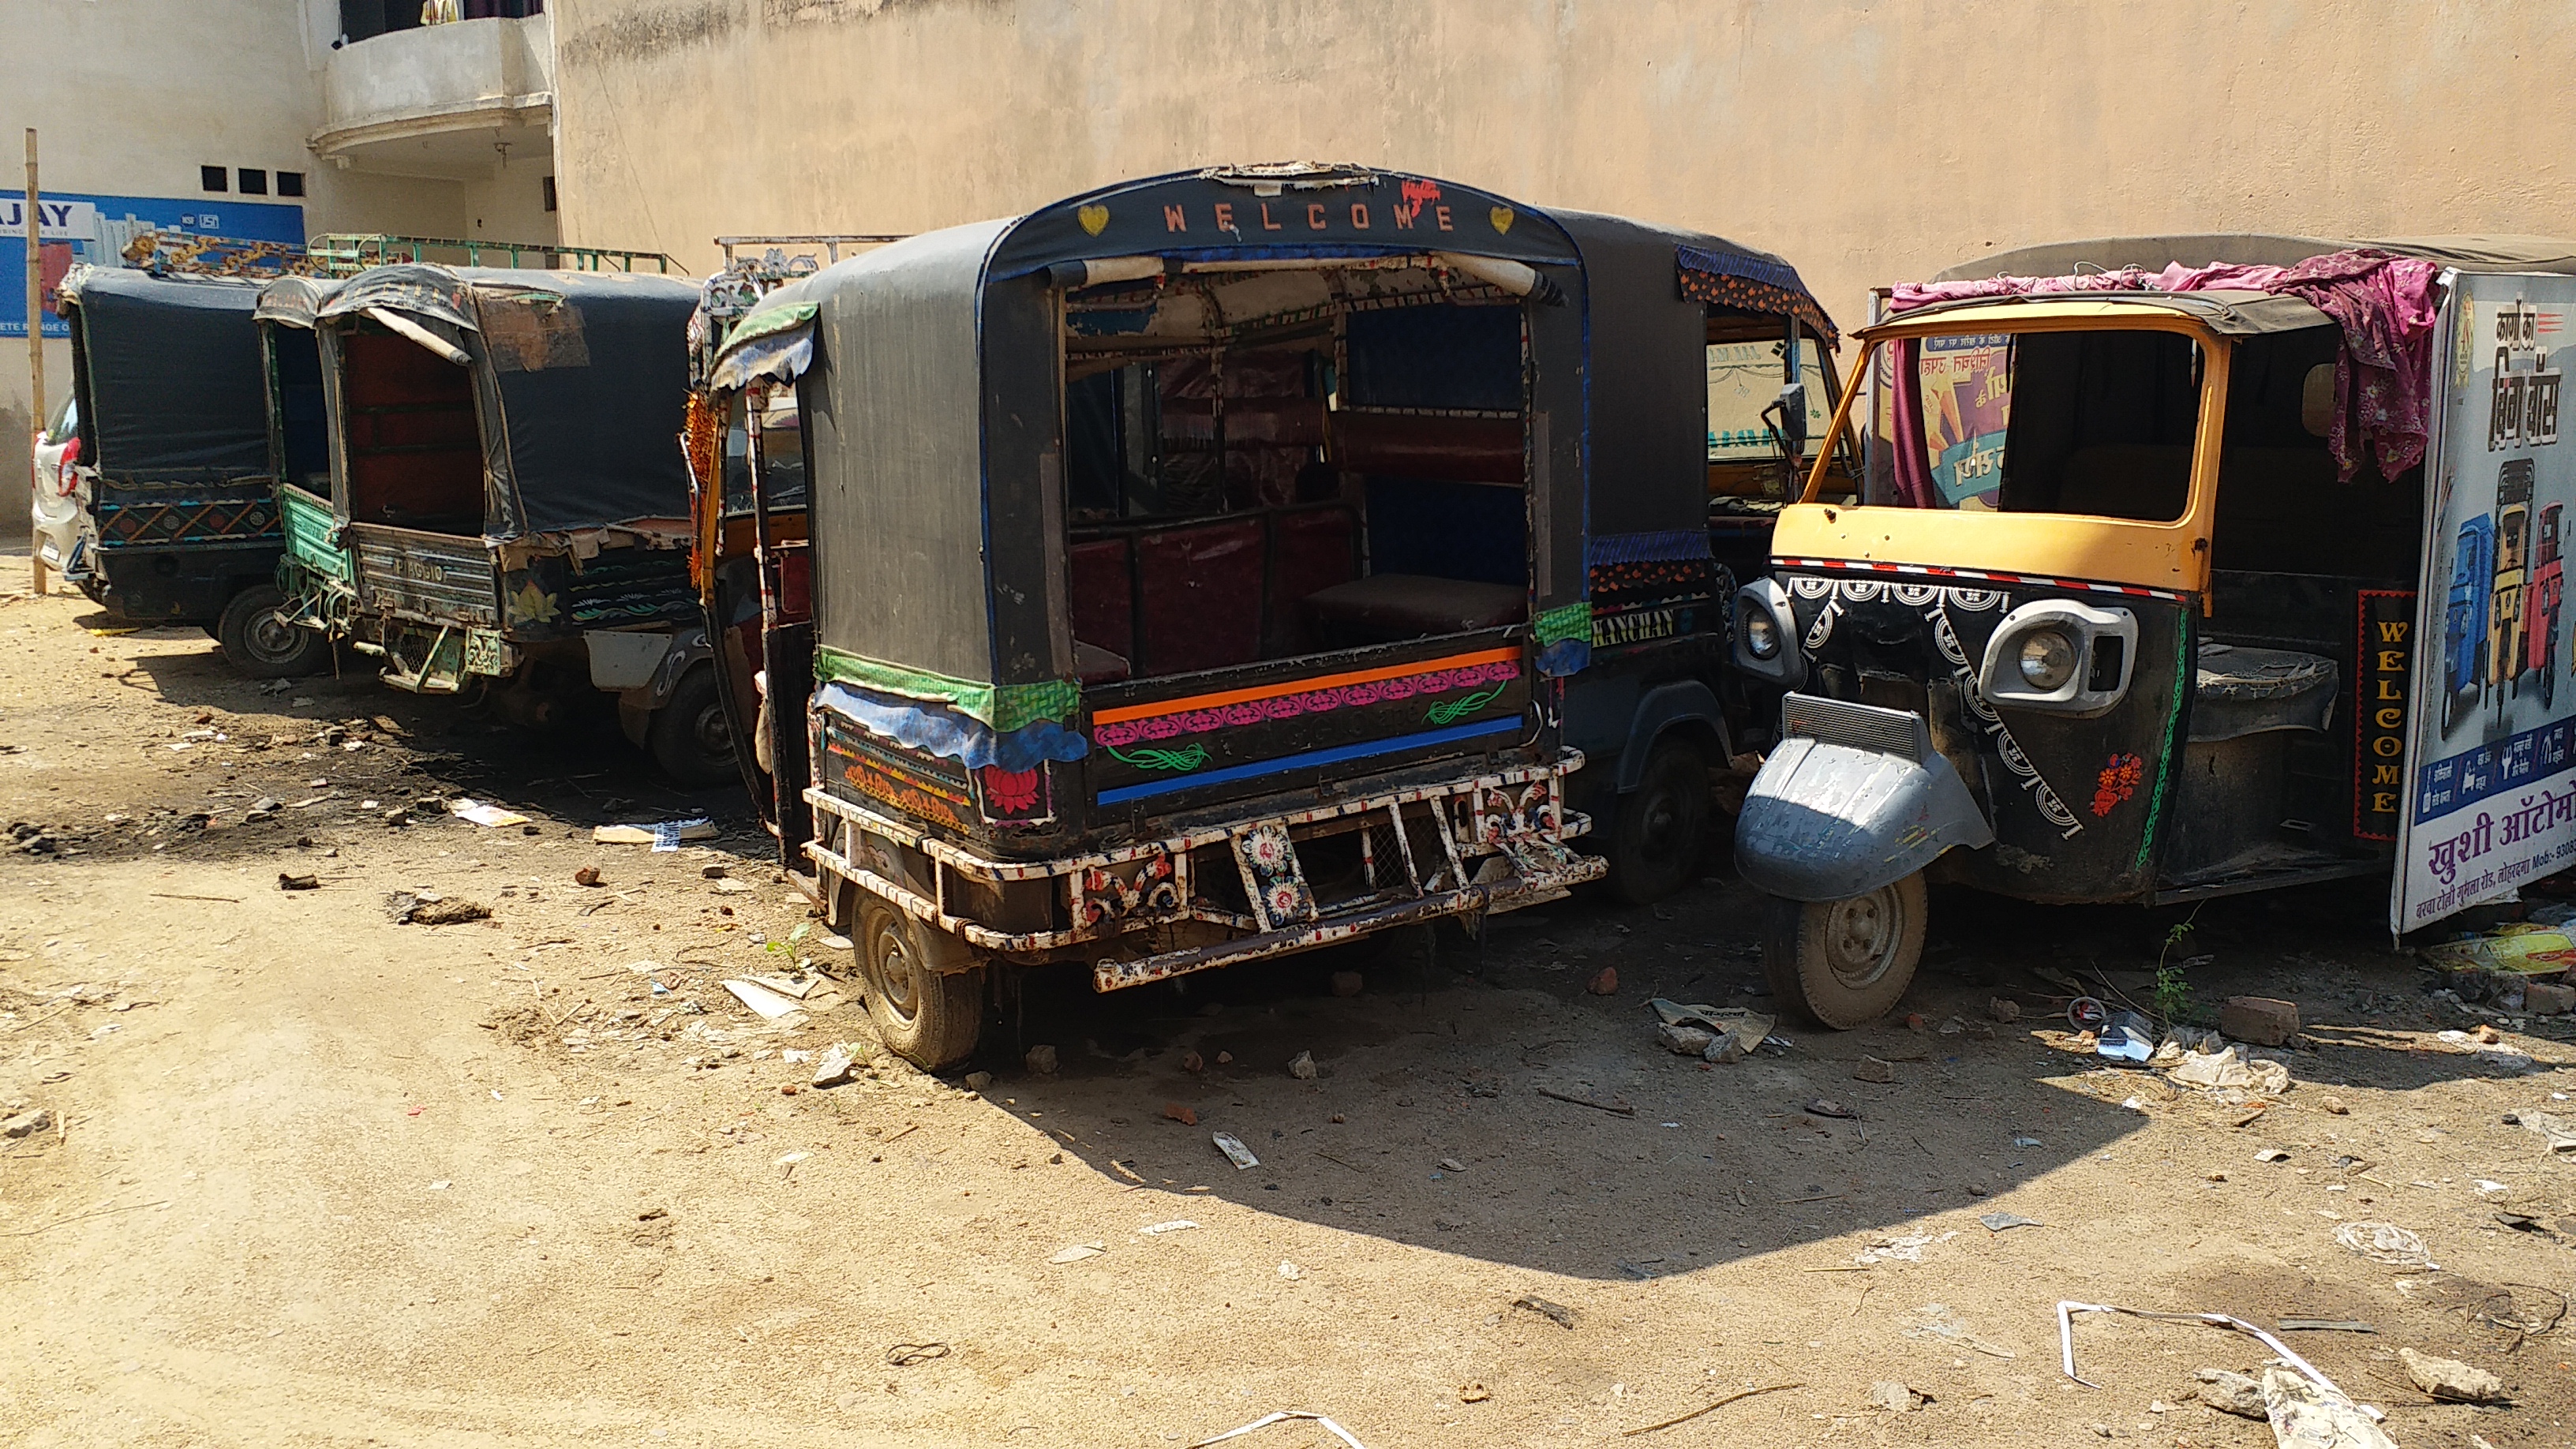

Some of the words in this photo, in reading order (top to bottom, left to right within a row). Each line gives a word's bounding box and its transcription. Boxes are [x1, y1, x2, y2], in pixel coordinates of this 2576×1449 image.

[0, 203, 73, 227] JAY
[1163, 200, 1455, 234] WELCOME
[22, 322, 60, 332] RNGE
[2489, 346, 2525, 448] बिग
[2526, 354, 2562, 444] बॉस
[2371, 620, 2409, 813] WELCOME
[2428, 811, 2495, 885] खुशी
